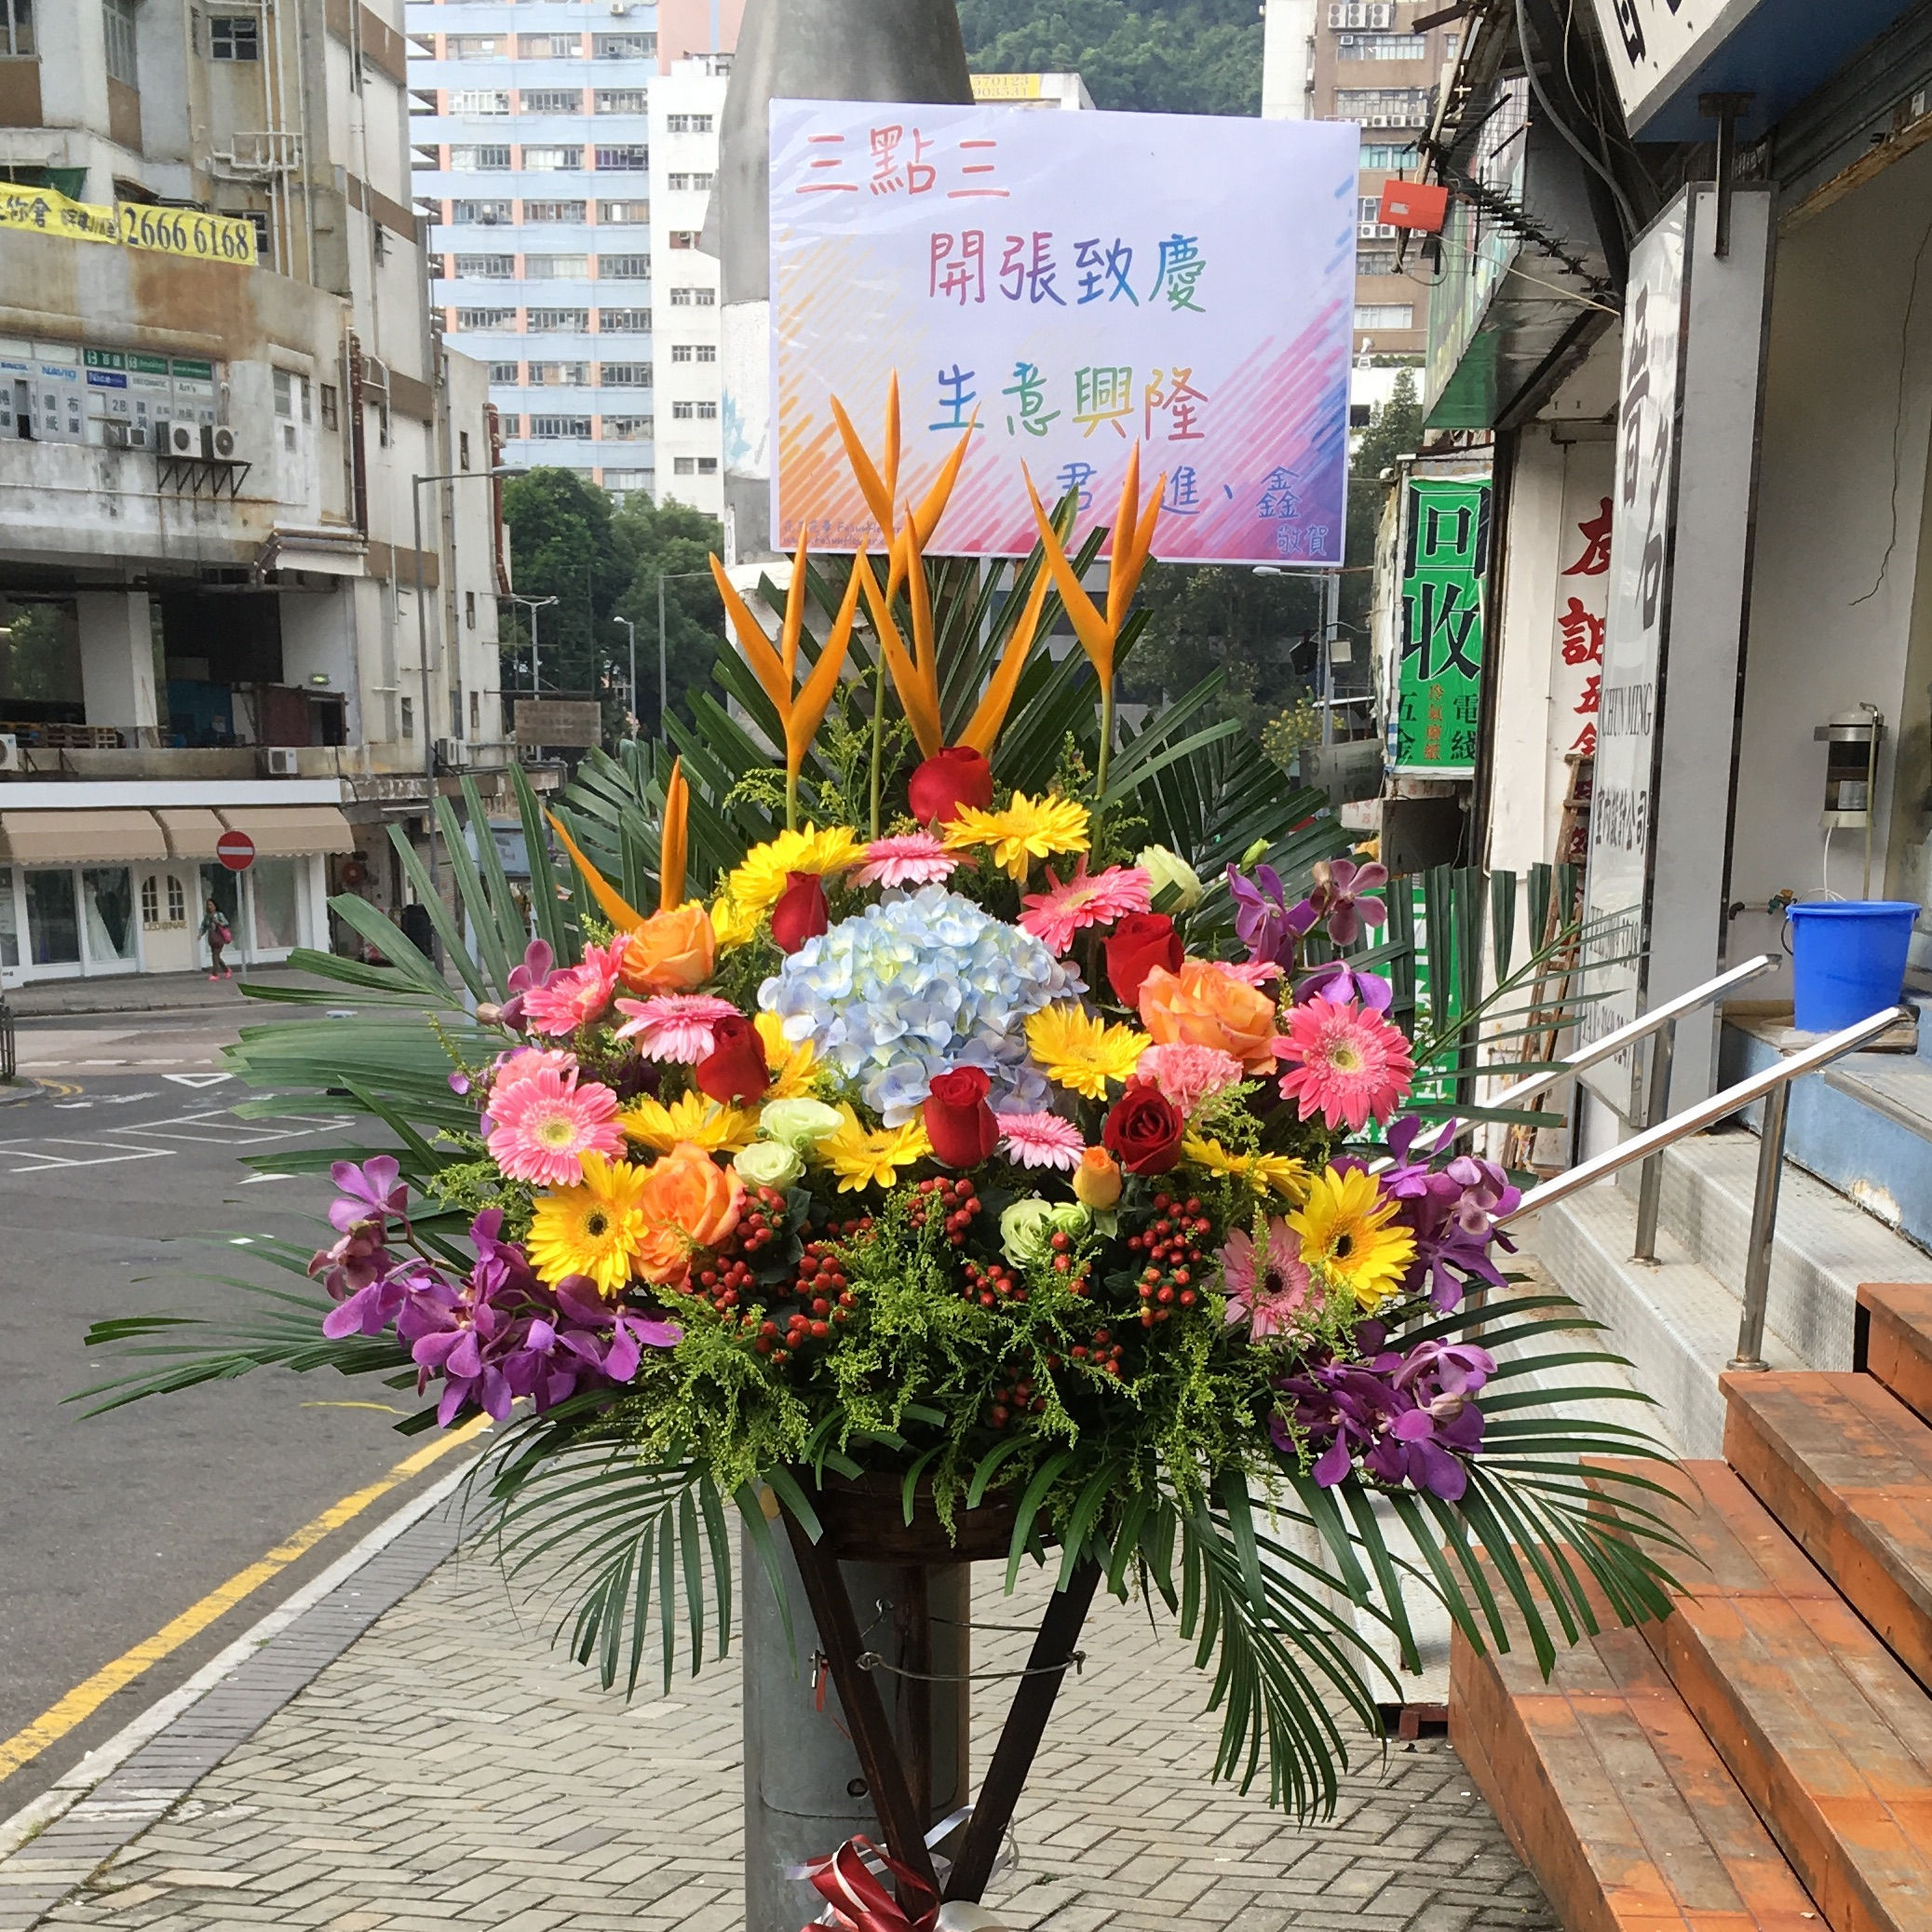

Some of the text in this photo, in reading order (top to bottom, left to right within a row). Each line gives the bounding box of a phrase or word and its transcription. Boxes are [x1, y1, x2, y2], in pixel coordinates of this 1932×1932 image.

[796, 124, 1010, 198] 三點三
[124, 207, 187, 251] 2666
[194, 217, 250, 261] 6168
[929, 231, 1207, 314] 開張致慶
[928, 360, 1209, 441] 生意興隆
[1277, 524, 1329, 556] 敬賀
[1402, 484, 1491, 681] 回收
